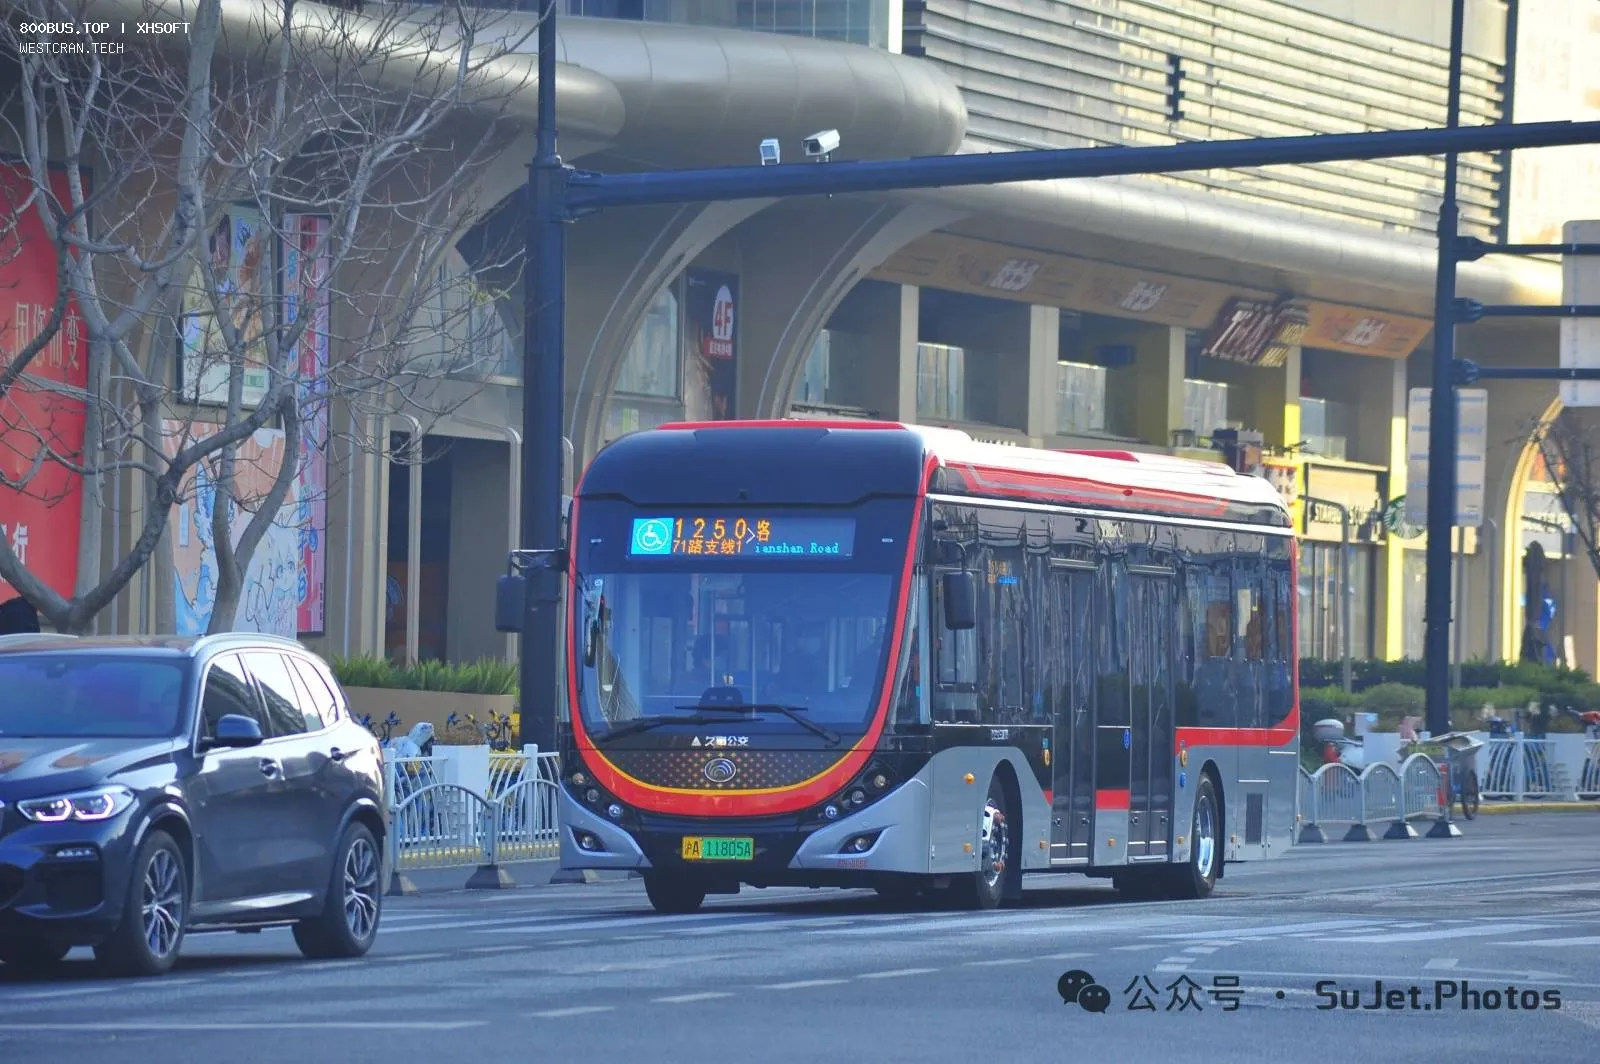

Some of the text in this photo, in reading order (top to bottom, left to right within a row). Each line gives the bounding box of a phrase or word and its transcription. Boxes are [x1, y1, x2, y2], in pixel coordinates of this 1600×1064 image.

[673, 539, 742, 555] 71路支线1
[810, 542, 839, 553] Road
